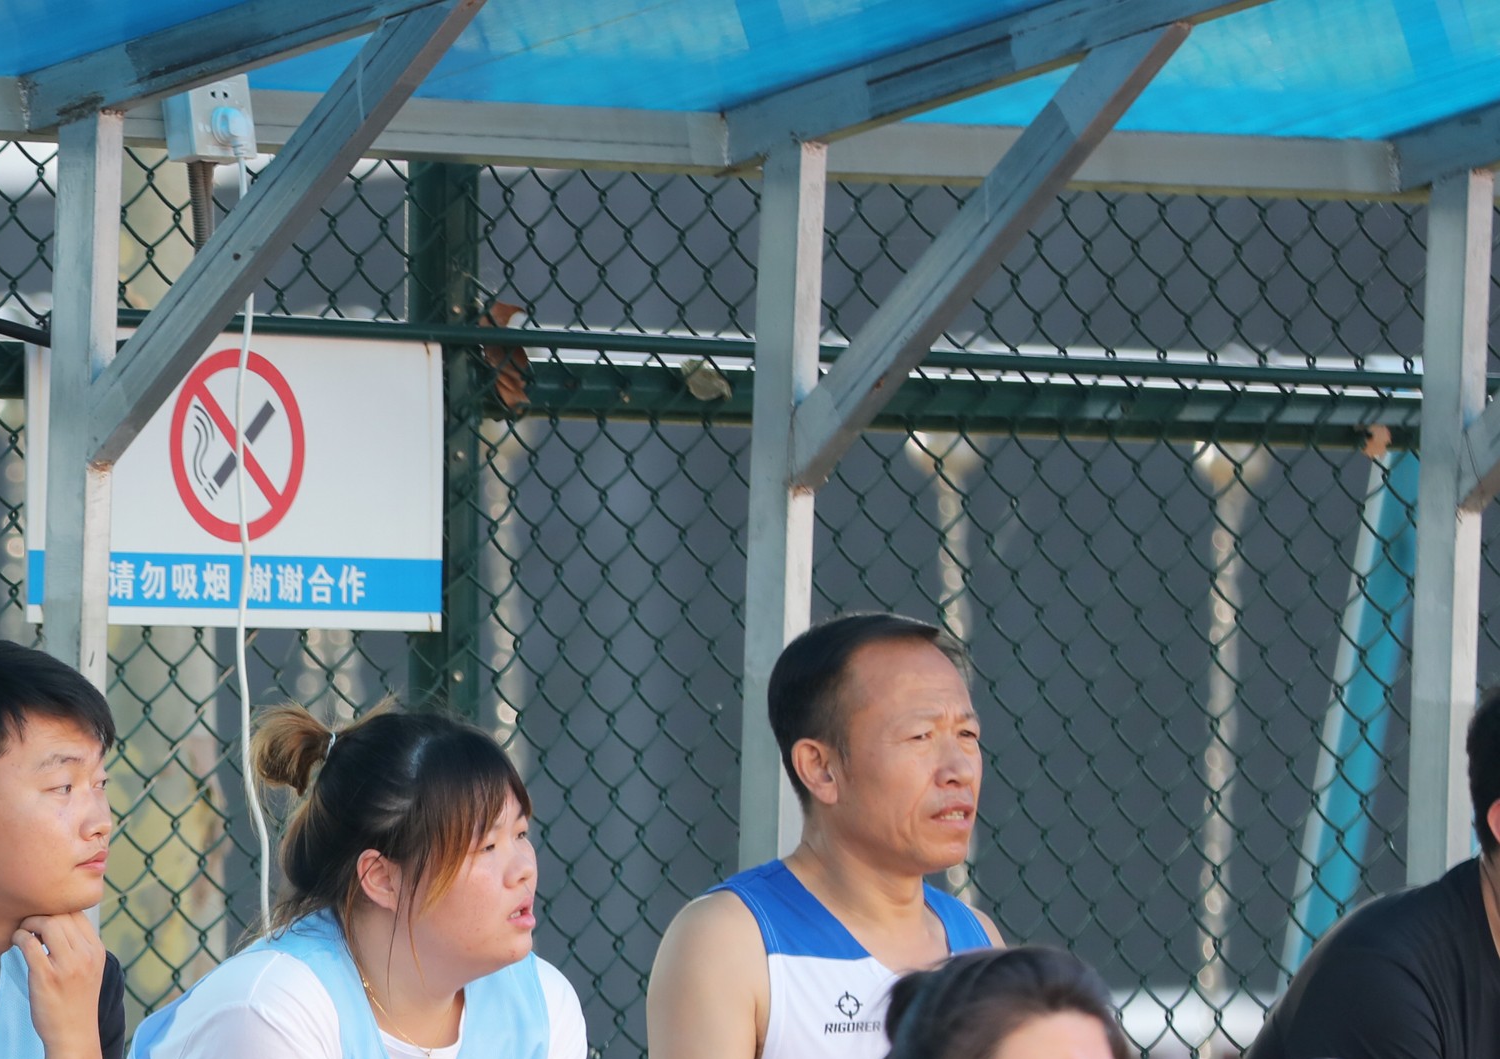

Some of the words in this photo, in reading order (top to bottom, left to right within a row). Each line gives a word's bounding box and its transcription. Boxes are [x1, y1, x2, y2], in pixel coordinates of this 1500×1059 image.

[108, 560, 231, 602] 请勿吸烟
[247, 563, 367, 604] 谢谢合作
[823, 1021, 881, 1035] RIGORER
